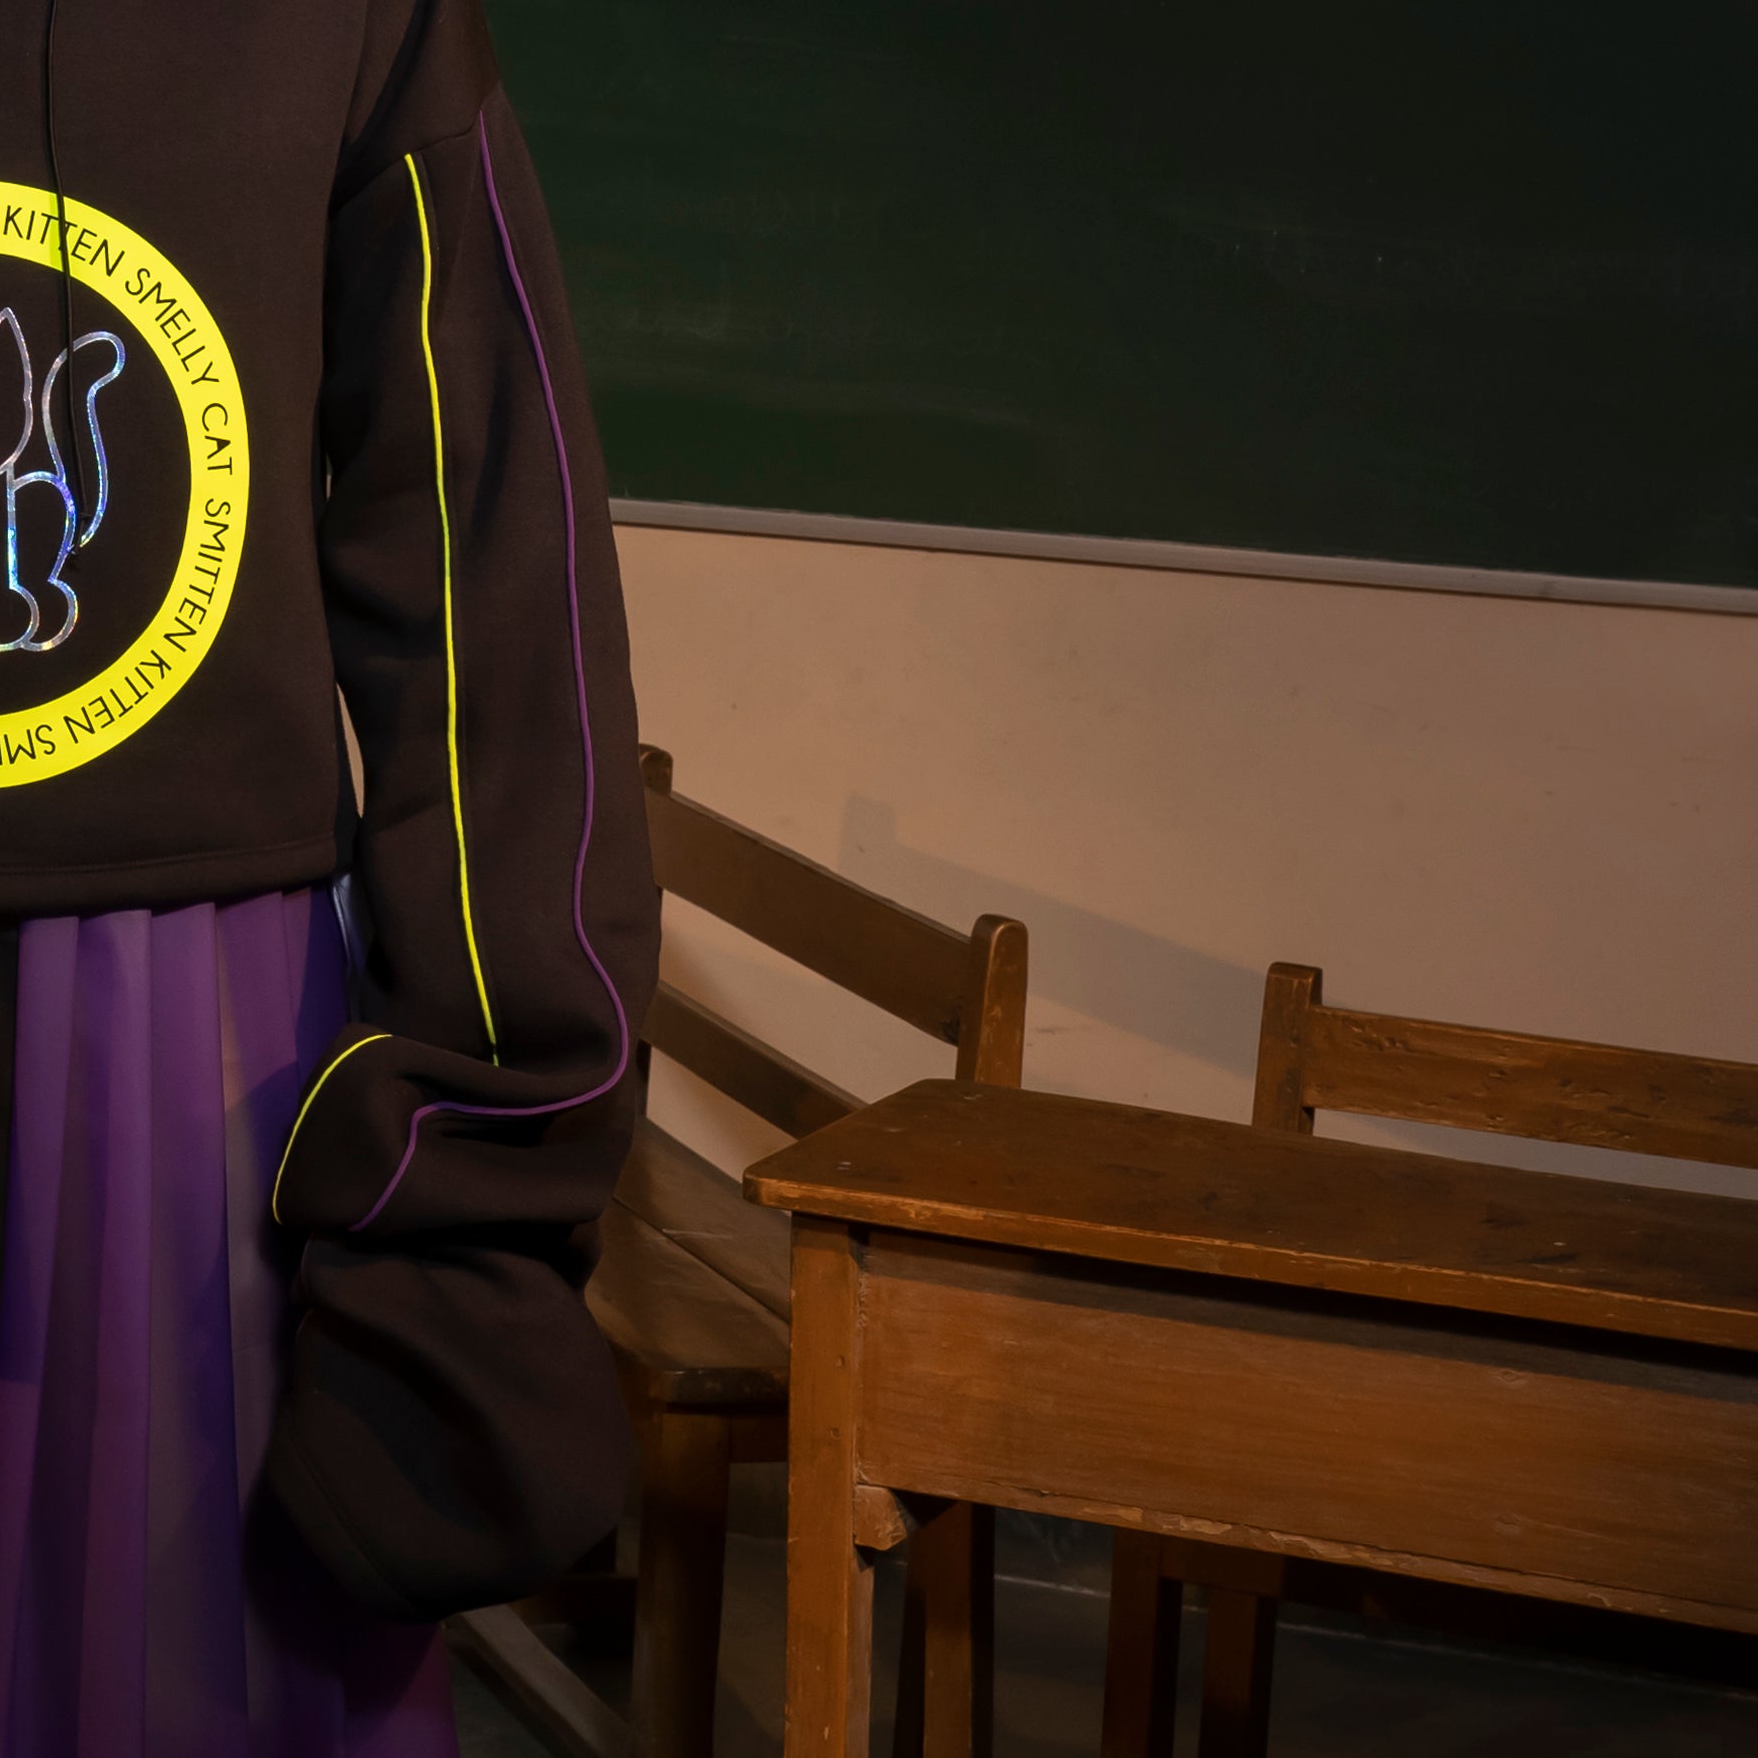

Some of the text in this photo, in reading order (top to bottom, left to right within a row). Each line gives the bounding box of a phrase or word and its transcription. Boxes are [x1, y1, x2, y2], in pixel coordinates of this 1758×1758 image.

[3, 205, 125, 277] KITTEN
[125, 268, 220, 385] SMELLY
[202, 402, 233, 475] CAT
[163, 498, 231, 653] SMITTEN
[63, 649, 172, 744] KITTEN
